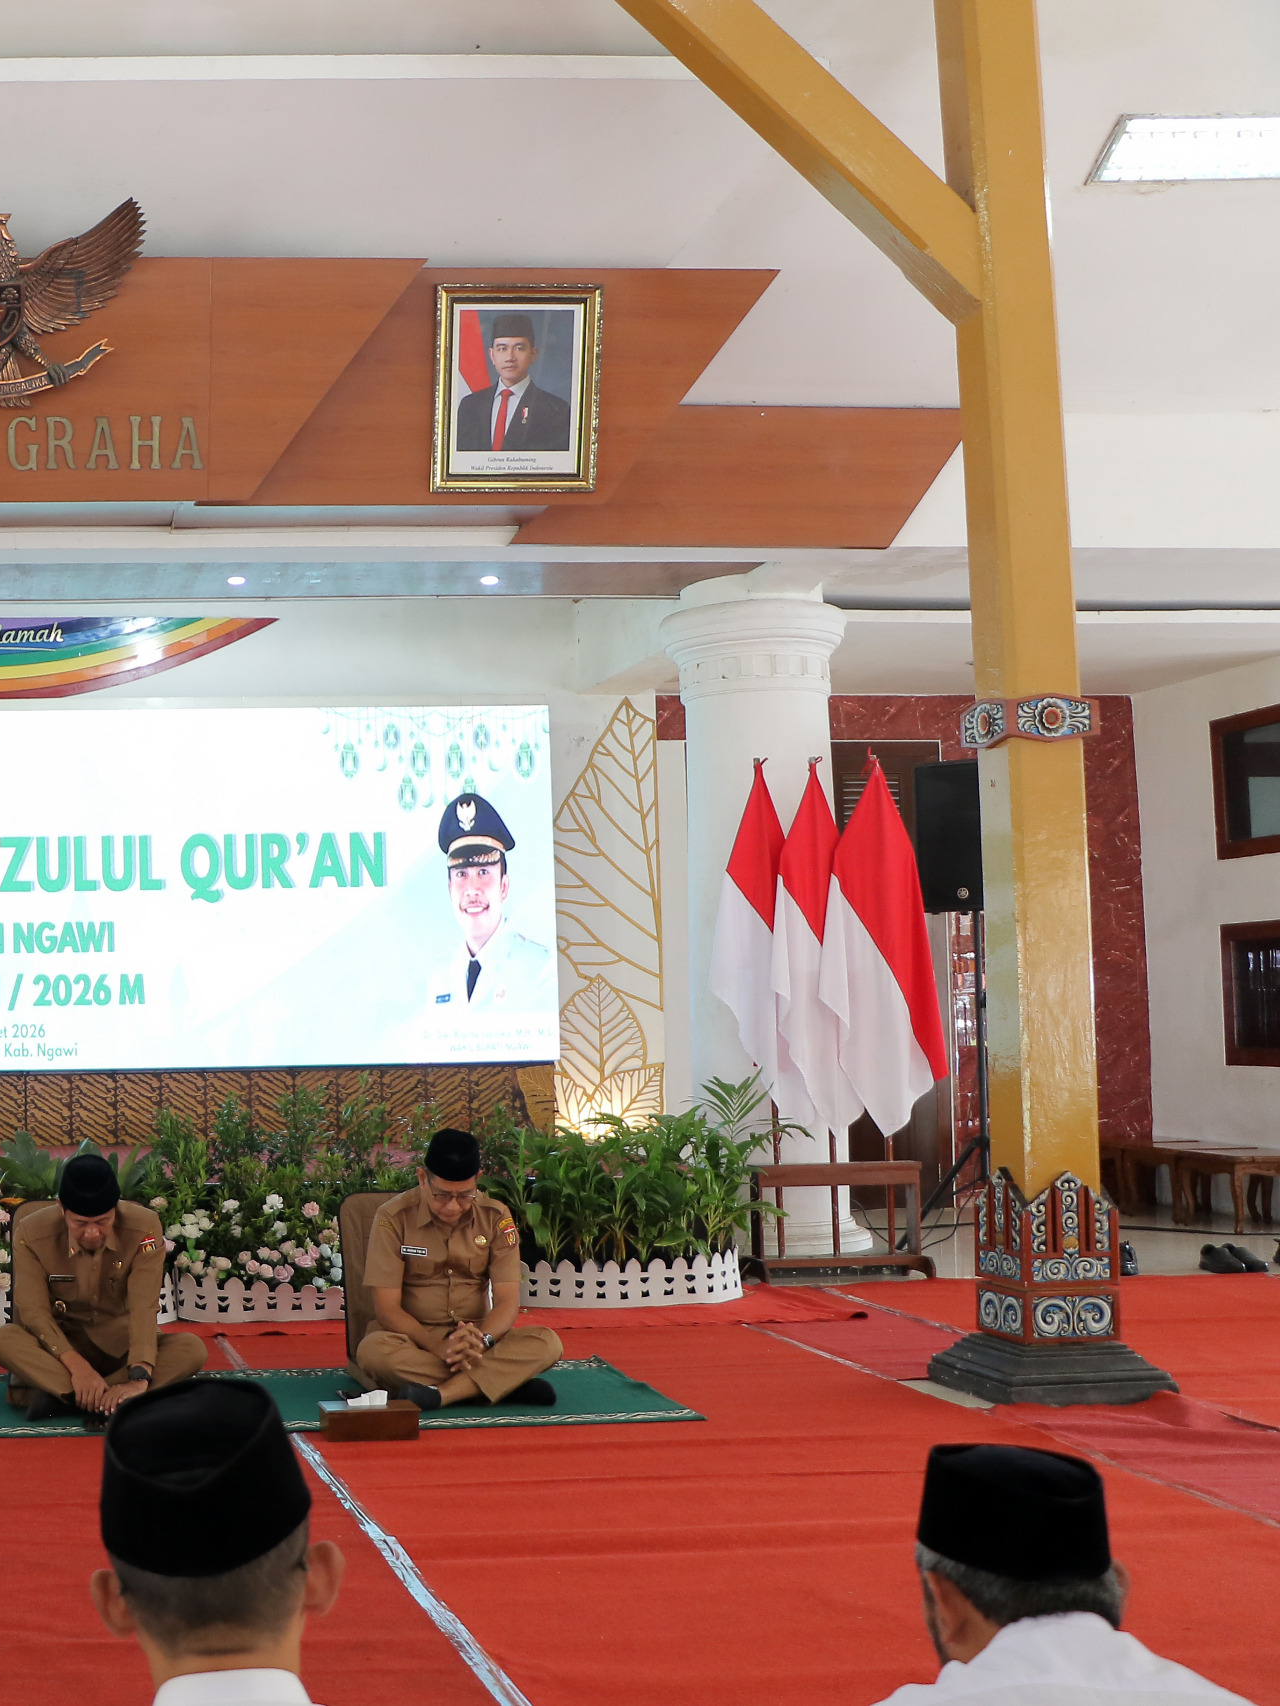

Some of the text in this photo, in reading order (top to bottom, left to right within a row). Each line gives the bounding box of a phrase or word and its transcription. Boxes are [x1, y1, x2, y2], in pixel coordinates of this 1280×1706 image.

[32, 377, 49, 388] IKA
[7, 416, 205, 471] GRAHA
[13, 921, 115, 954] NGAWI
[8, 973, 23, 1011] /
[33, 974, 111, 1006] 2026
[119, 974, 145, 1005] M
[12, 1024, 45, 1038] 2026
[5, 1042, 32, 1057] Kab.
[37, 1043, 77, 1061] Ngawi
